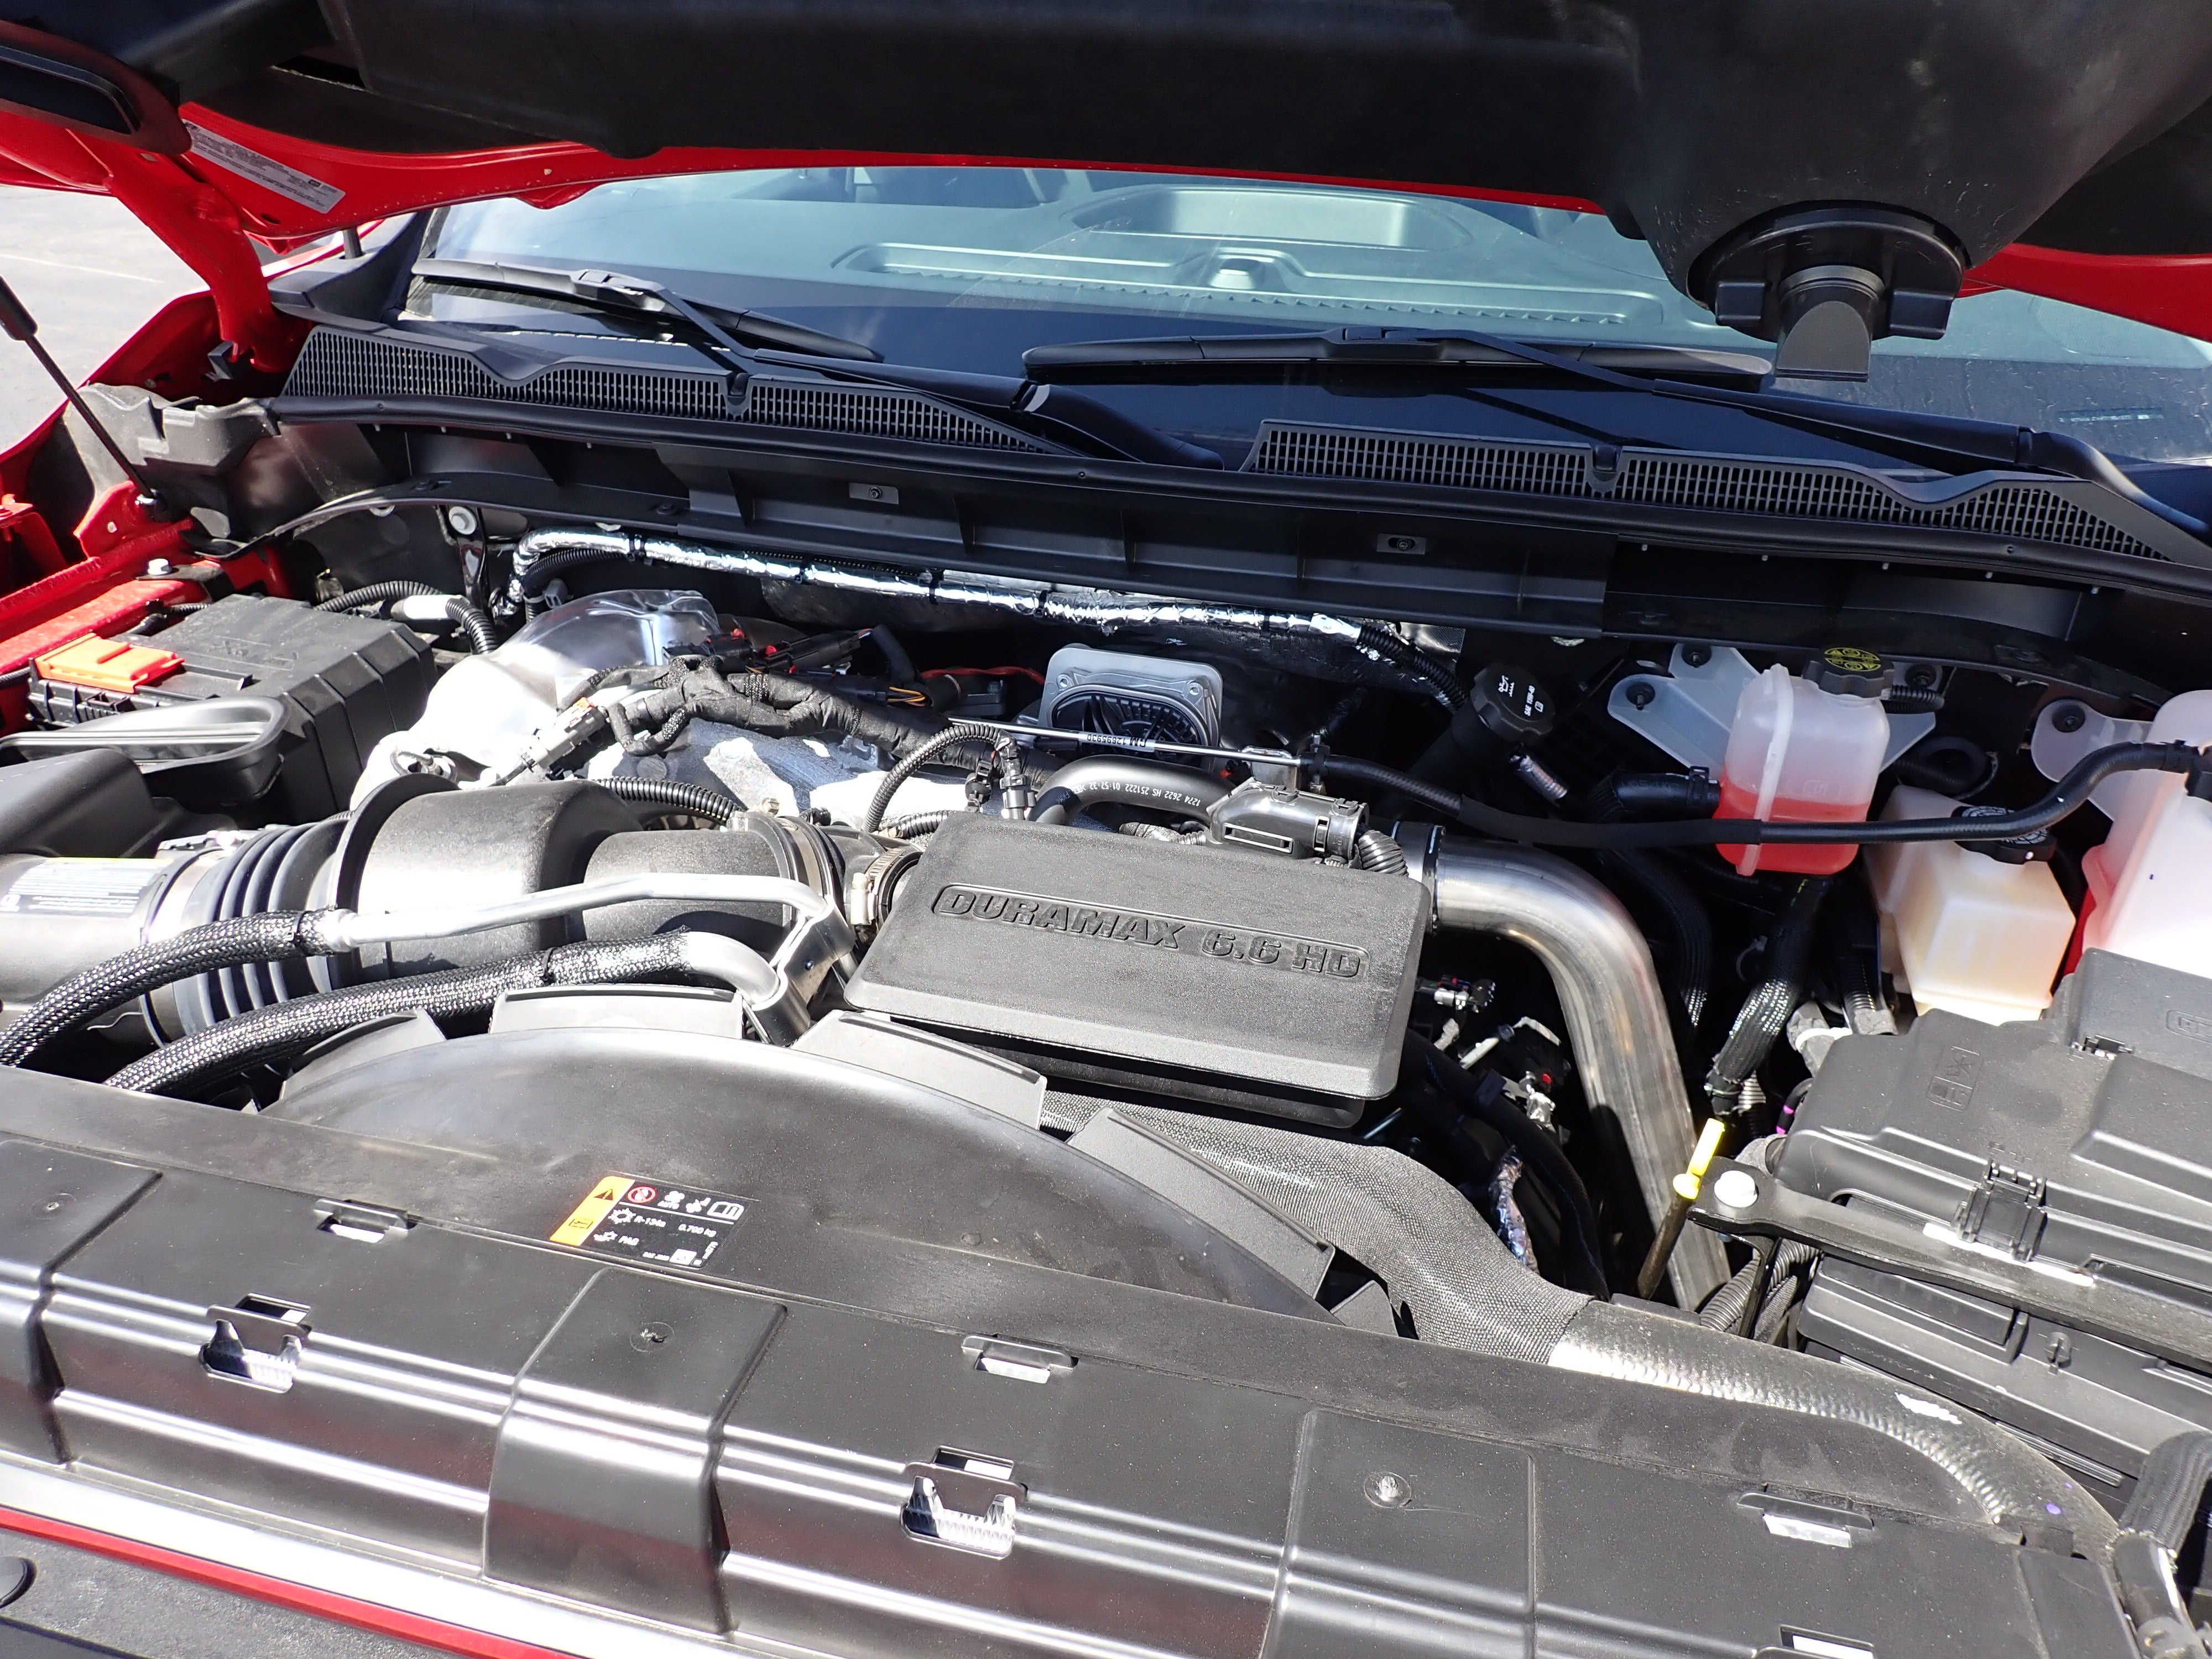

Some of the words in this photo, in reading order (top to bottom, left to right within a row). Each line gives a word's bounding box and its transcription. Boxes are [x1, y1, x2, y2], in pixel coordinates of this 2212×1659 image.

[1129, 737, 1147, 747] GM
[1089, 781, 1121, 790] 01:57:32
[1125, 783, 1150, 795] 251222
[1152, 788, 1162, 797] HS
[1164, 790, 1182, 801] 2622
[1185, 796, 1201, 807] 1274
[937, 889, 1186, 949] DURAMAX
[1200, 928, 1282, 964] 6.6
[1291, 944, 1362, 978] HD
[658, 1201, 680, 1209] AUTO
[634, 1215, 666, 1228] R-134a
[678, 1223, 704, 1234] 0.700
